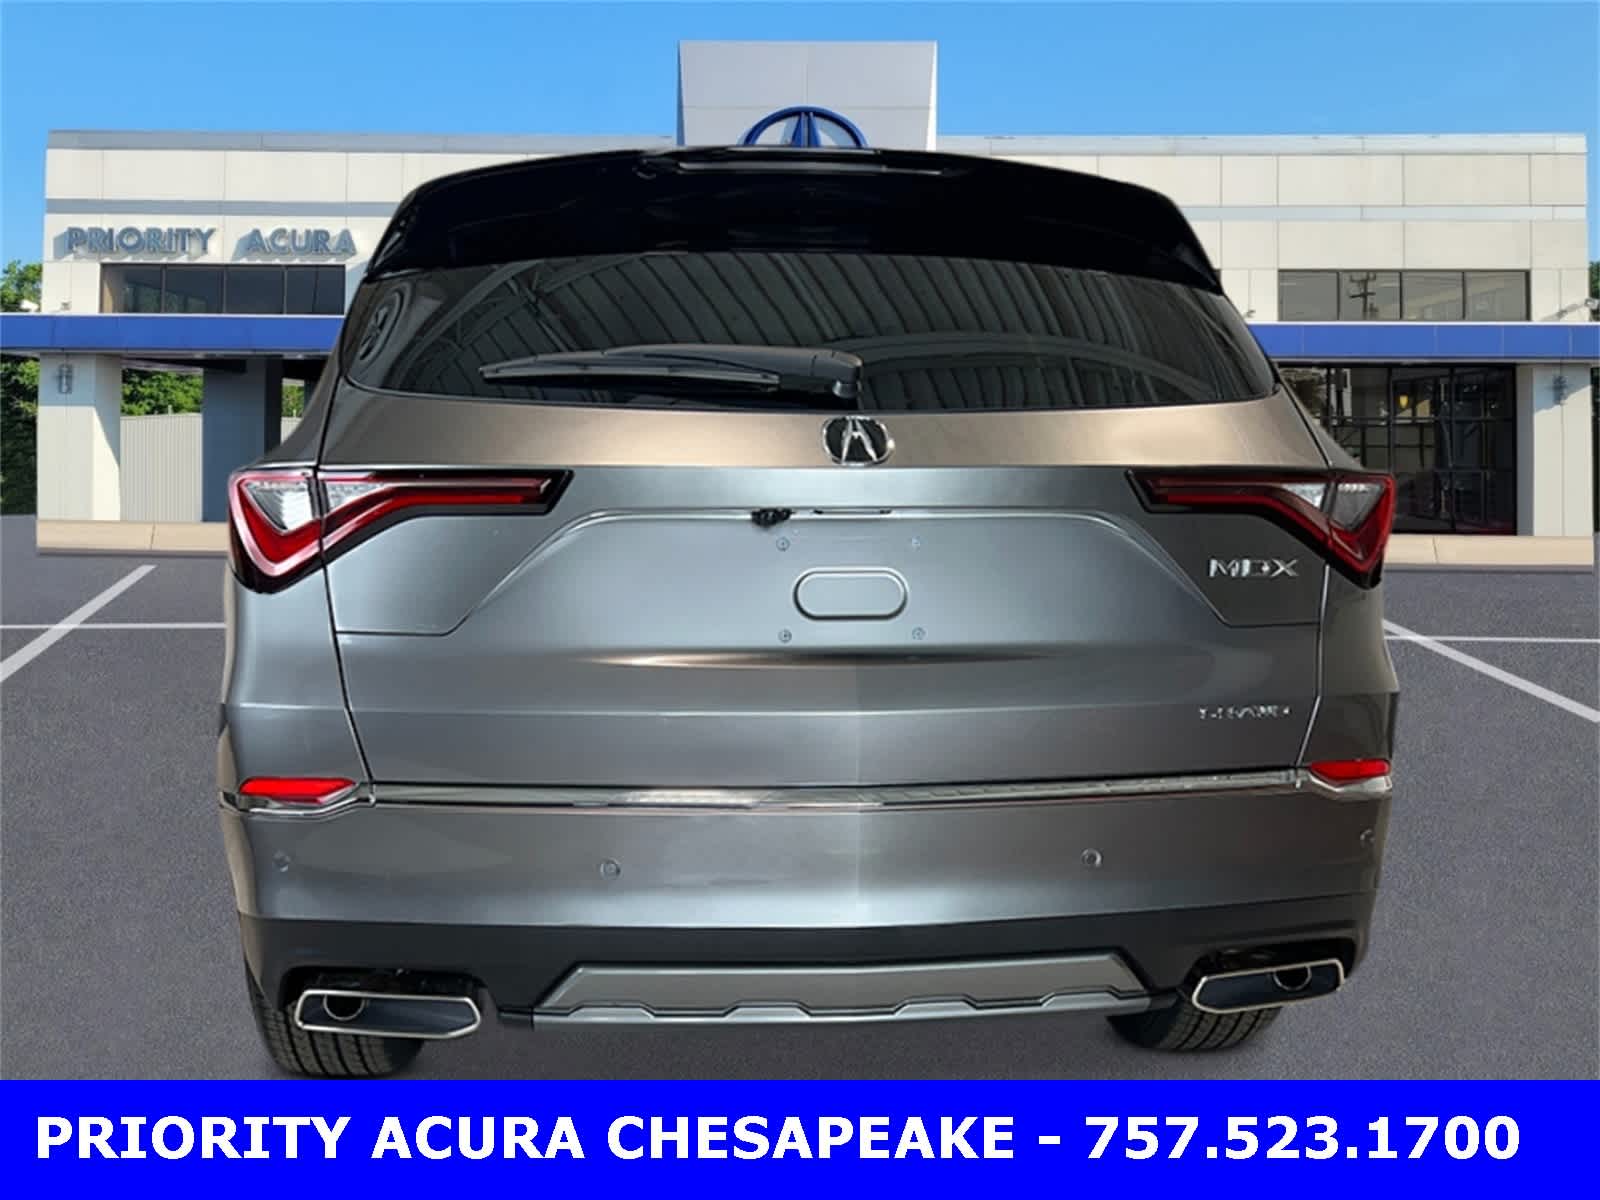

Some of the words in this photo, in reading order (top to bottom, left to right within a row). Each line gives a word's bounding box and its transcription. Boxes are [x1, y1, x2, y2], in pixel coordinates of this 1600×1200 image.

[65, 226, 215, 255] PRIORITY
[245, 227, 357, 256] ACURA
[1208, 559, 1298, 578] MDX
